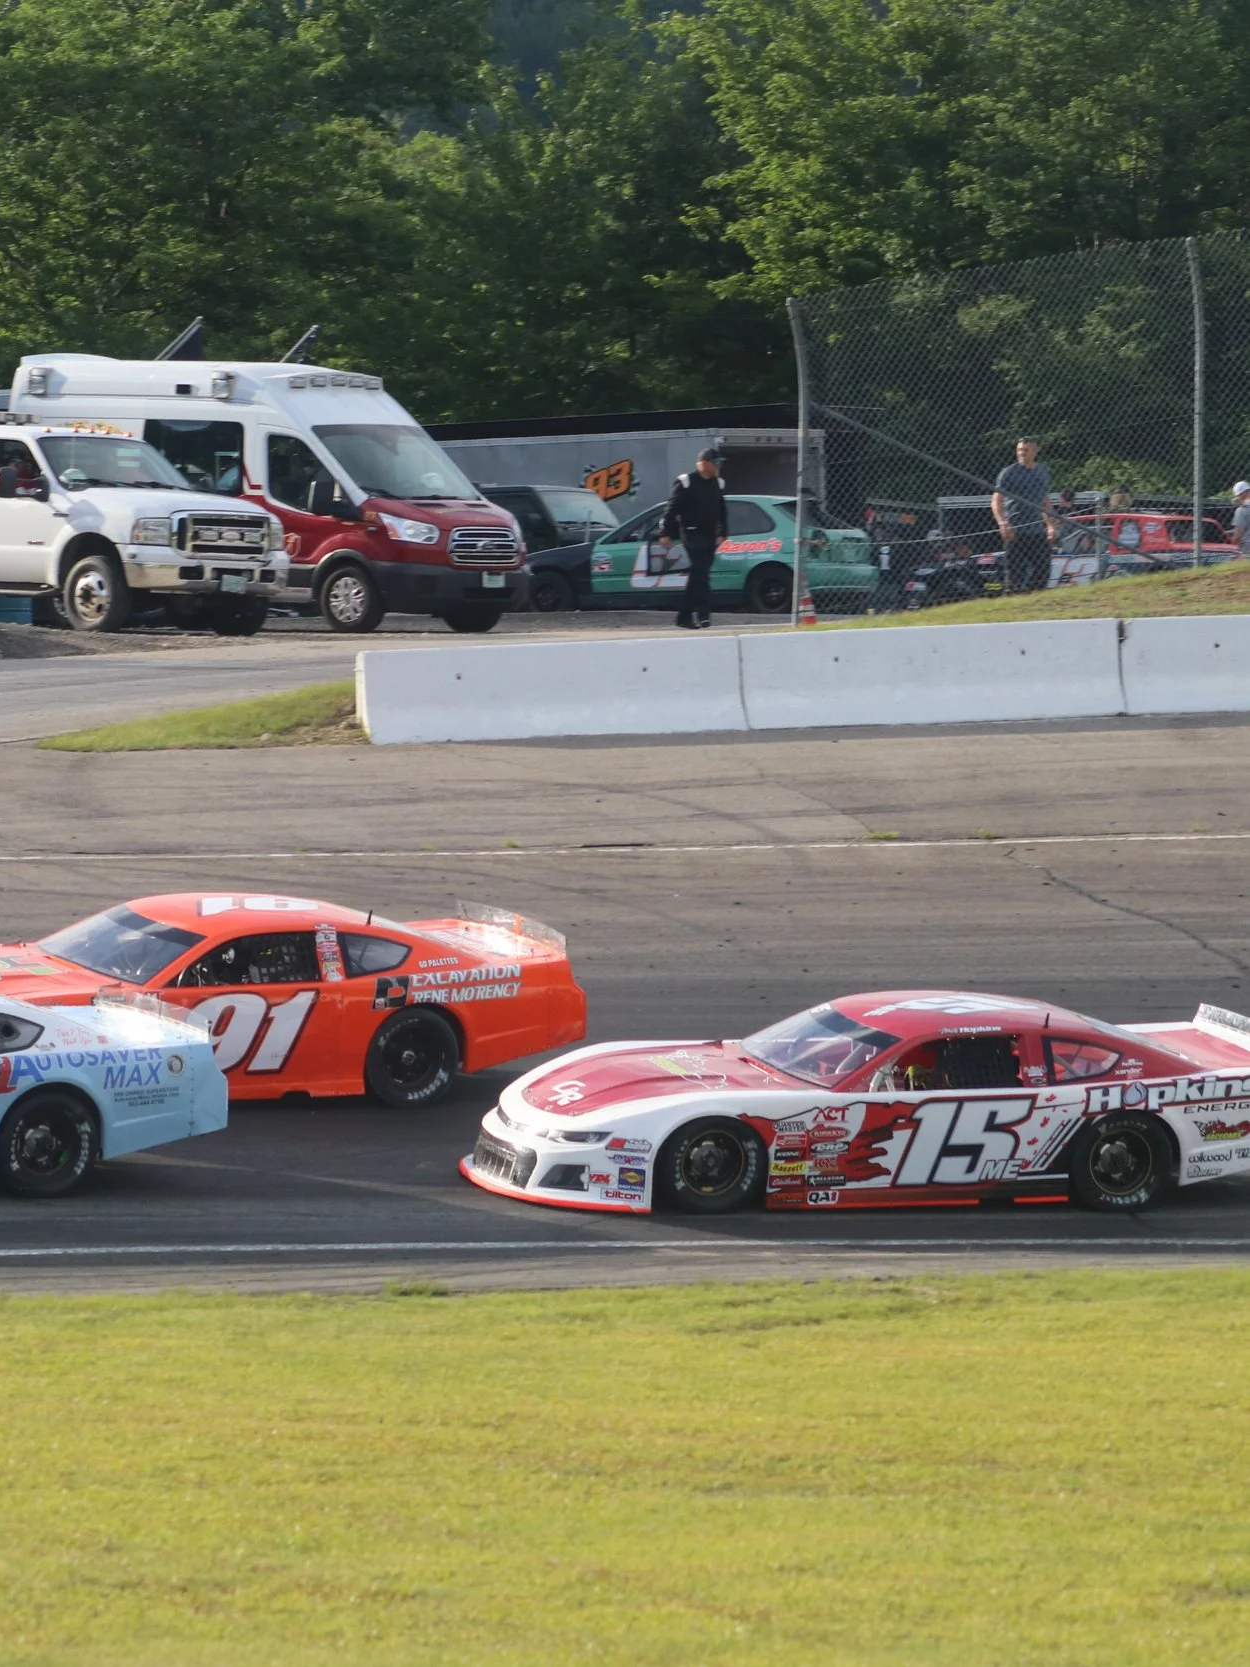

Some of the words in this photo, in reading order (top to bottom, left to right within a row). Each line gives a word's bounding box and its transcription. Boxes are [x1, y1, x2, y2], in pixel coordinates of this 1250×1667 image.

[186, 988, 322, 1076] 91
[103, 1061, 162, 1090] MAX
[813, 1106, 849, 1122] ACT
[891, 1094, 1038, 1187] 15
[772, 1163, 804, 1173] Bassett
[978, 1158, 1025, 1181] ME
[604, 1190, 642, 1201] tilton
[809, 1191, 838, 1204] QA1
